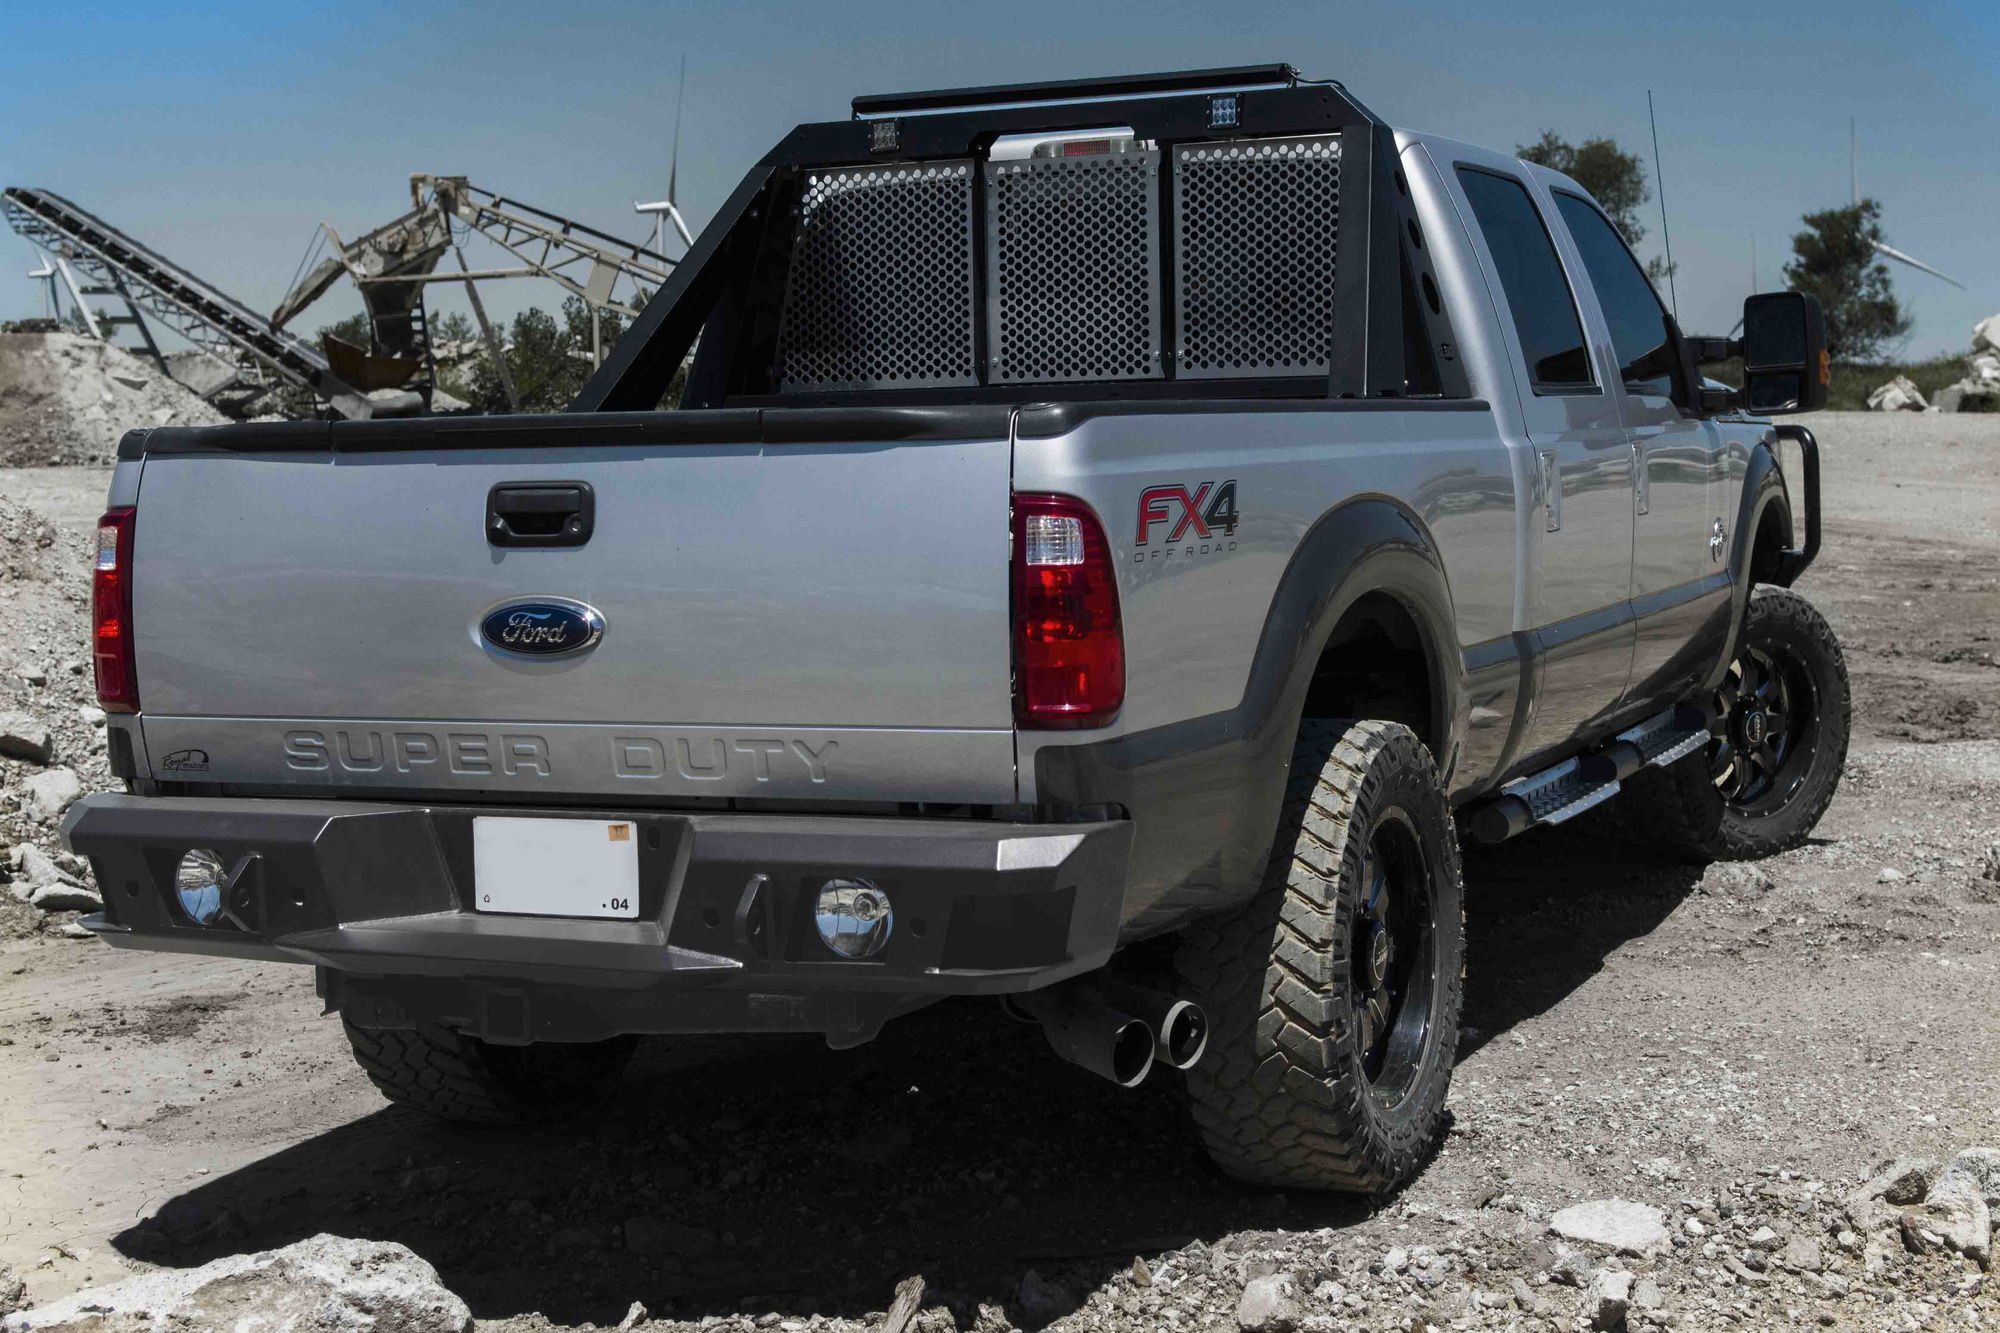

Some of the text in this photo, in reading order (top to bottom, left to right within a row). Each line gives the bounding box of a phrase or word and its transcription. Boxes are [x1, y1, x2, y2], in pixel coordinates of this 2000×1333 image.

[1136, 479, 1239, 546] FX4
[1135, 541, 1237, 563] OFF ROAD
[502, 611, 567, 643] Ford
[162, 751, 192, 772] Royal
[283, 730, 839, 783] SUPER DUTY
[611, 898, 629, 910] 04
